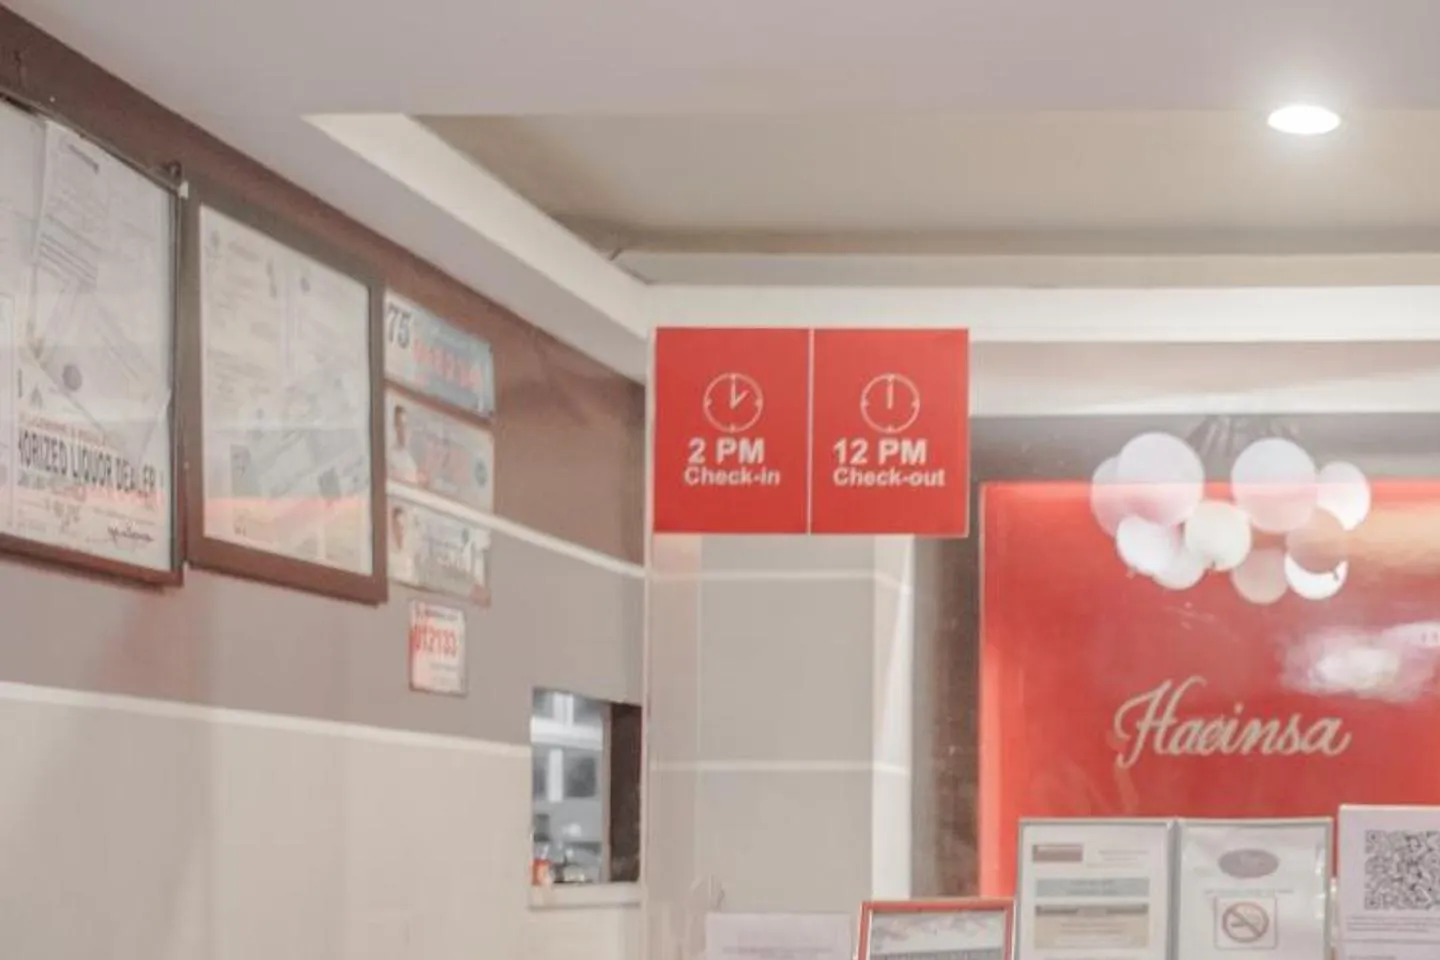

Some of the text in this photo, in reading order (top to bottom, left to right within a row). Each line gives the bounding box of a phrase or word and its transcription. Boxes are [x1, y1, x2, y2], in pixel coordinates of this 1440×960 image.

[688, 438, 765, 464] 2 PM
[833, 439, 928, 464] 12 PM
[70, 443, 114, 487] LIQUOR
[684, 467, 781, 486] Check-in
[833, 467, 946, 487] Check-out
